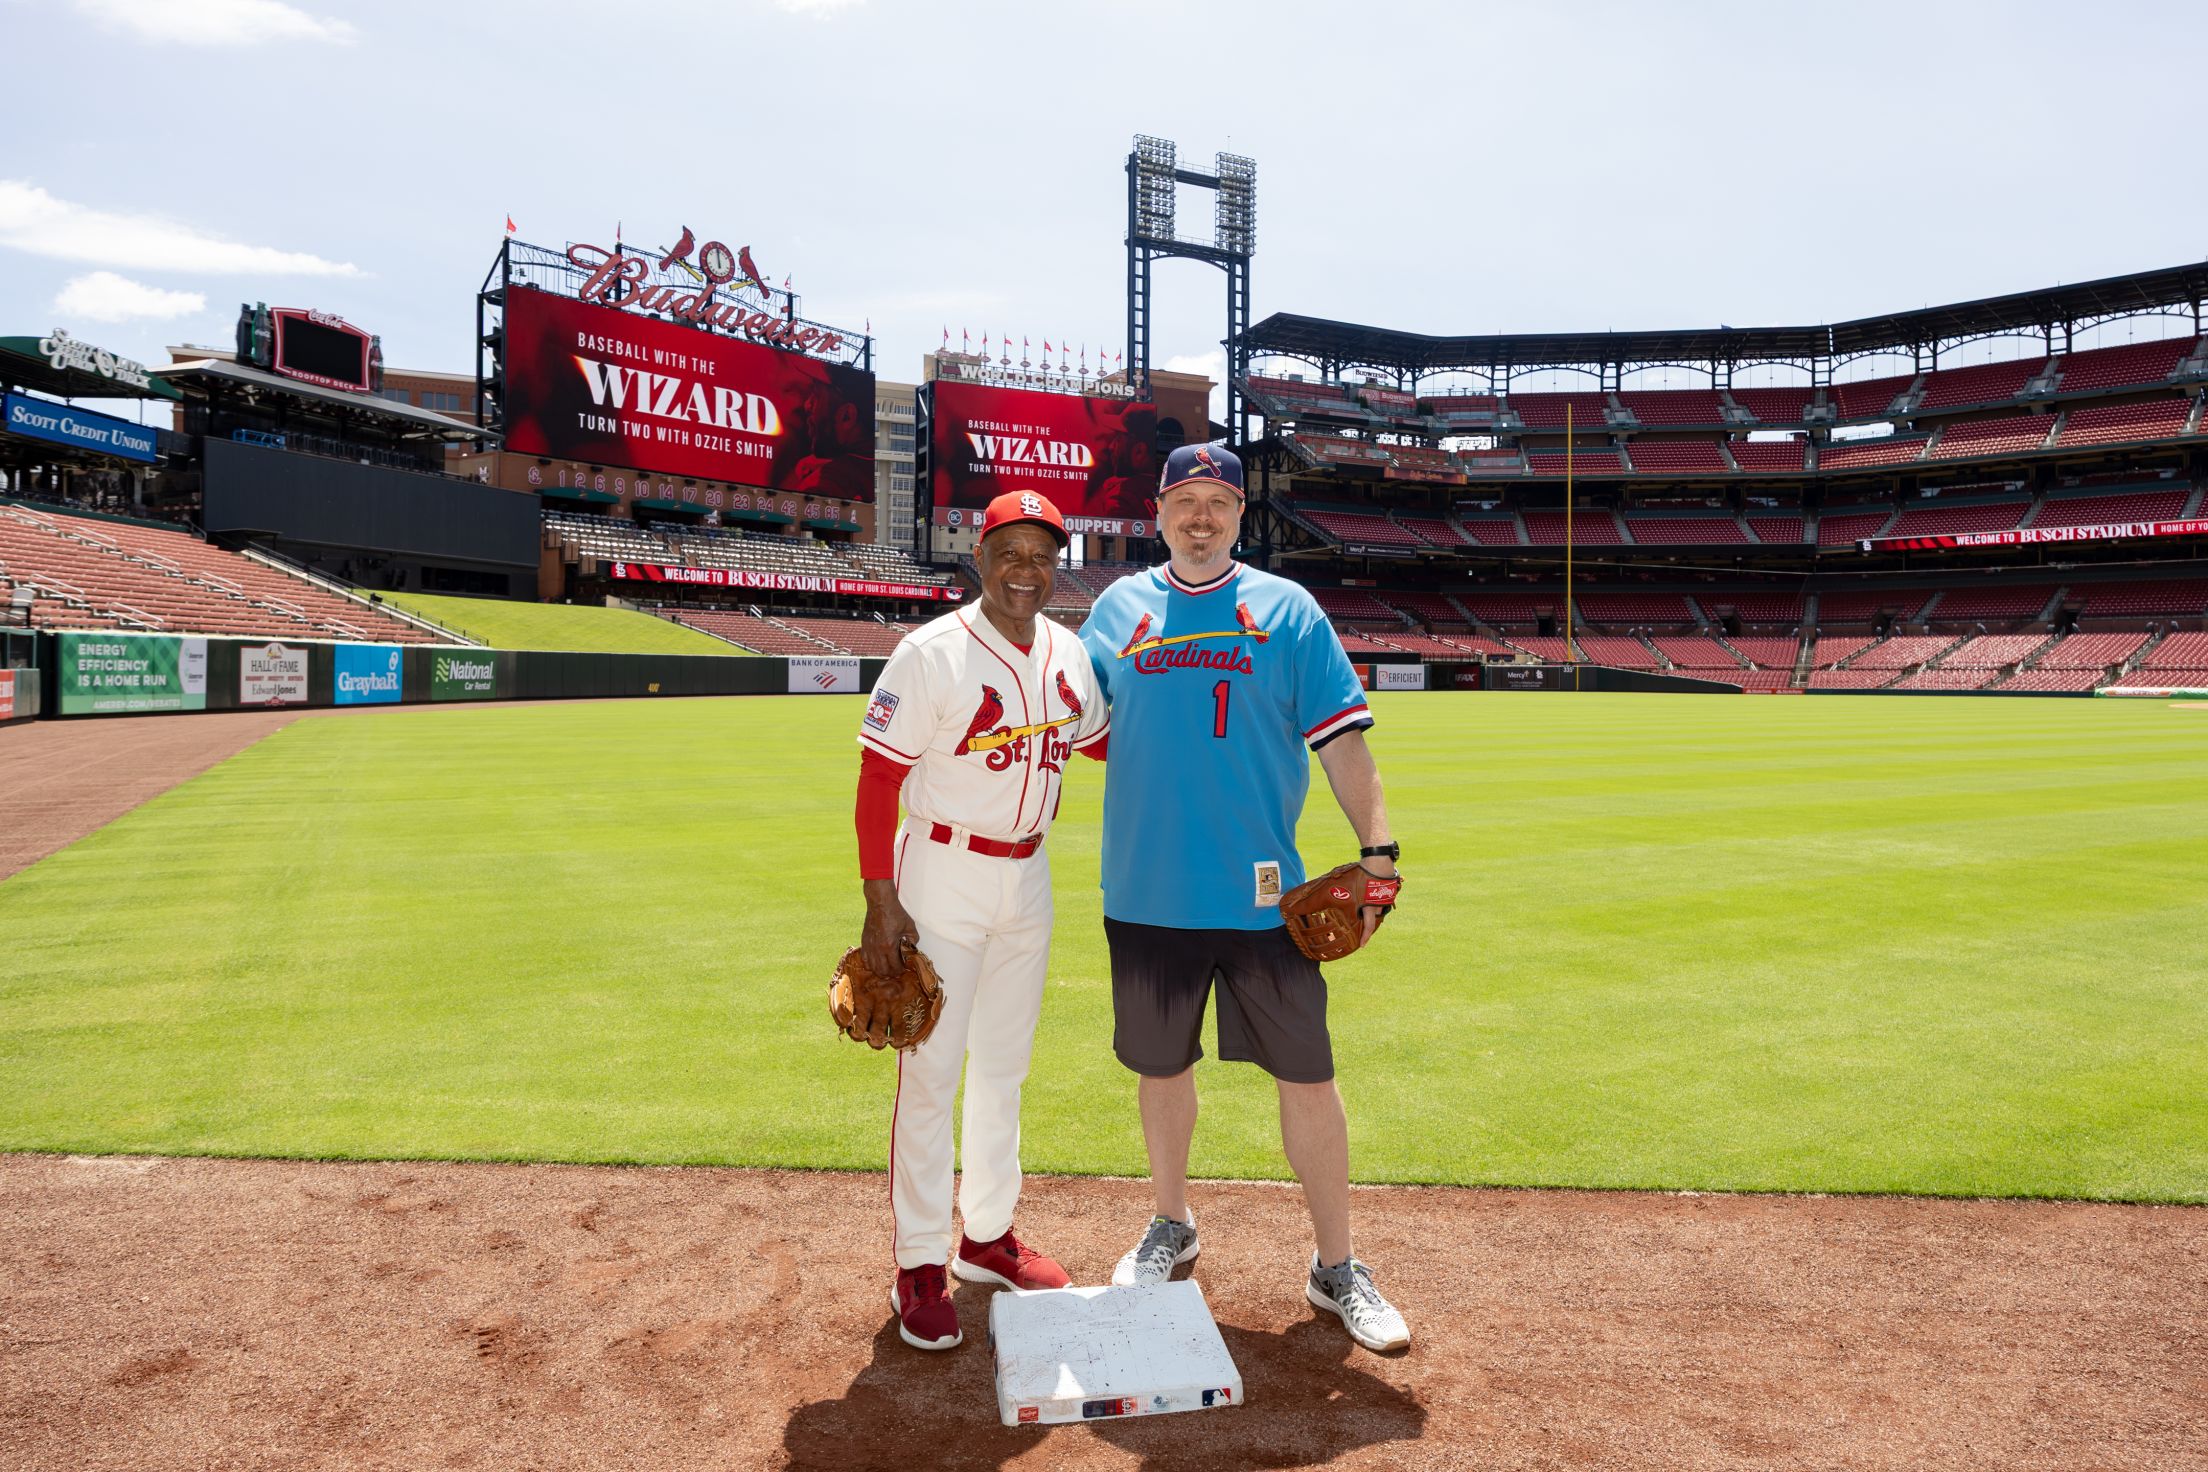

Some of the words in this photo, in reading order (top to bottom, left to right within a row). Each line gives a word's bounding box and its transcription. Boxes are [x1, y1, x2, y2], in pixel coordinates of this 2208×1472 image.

[567, 243, 843, 353] Budweiser
[308, 308, 344, 329] Coca-Cola
[578, 332, 648, 362] BASEBALL
[654, 348, 686, 370] WITH
[691, 356, 716, 376] THE
[115, 371, 152, 389] DECK
[292, 371, 331, 385] ROOFTOP
[333, 380, 354, 390] DECK
[958, 364, 1027, 384] WORLD
[1031, 373, 1136, 397] CHAMPIONS
[574, 354, 785, 436] WIZARD
[11, 405, 59, 431] SCOTT
[60, 417, 110, 443] CREDIT
[111, 429, 152, 453] UNION
[578, 412, 616, 434] TURN
[623, 420, 650, 440] TWO
[656, 426, 689, 446] WITH
[695, 433, 731, 454] OZZIE
[736, 440, 773, 460] SMITH
[968, 419, 1010, 432] BASEBALL
[1012, 423, 1032, 434] WITH
[1035, 426, 1051, 436] THE
[964, 432, 1096, 468] WIZARD
[969, 463, 991, 473] TURN
[994, 465, 1011, 475] TWO
[1014, 466, 1034, 477] WITH
[1037, 468, 1061, 479] OZZIE
[1063, 471, 1088, 481] SMITH
[558, 470, 566, 488] 1
[575, 472, 586, 489] 2
[594, 474, 606, 492] 6
[614, 477, 626, 495] 9
[634, 480, 650, 498] 10
[658, 483, 674, 500] 14
[682, 486, 698, 504] 17
[705, 490, 724, 507] 20
[732, 493, 750, 511] 23
[756, 496, 774, 513] 24
[780, 500, 797, 517] 42
[804, 503, 821, 520] 45
[824, 506, 840, 521] 85
[1063, 518, 1121, 534] OUPPEN
[1956, 535, 2001, 546] WELCOME
[2003, 533, 2015, 543] TO
[2020, 528, 2074, 543] BUSCH
[2076, 522, 2155, 540] STADIUM
[2160, 523, 2183, 533] HOME
[2186, 522, 2195, 531] OF
[2197, 521, 2208, 530] YO
[664, 567, 709, 583] WELCOME
[711, 571, 723, 583] TO
[728, 570, 775, 588] BUSCH
[776, 574, 836, 592] STADIUM
[839, 582, 856, 592] HOME
[857, 583, 864, 592] OF
[864, 584, 879, 593] YOUR
[880, 585, 888, 594] ST.
[889, 585, 904, 595] LOUIS
[904, 586, 933, 597] CARDINALS
[78, 643, 127, 656] ENERGY
[1134, 635, 1253, 675] Cardinals
[78, 660, 149, 671] EFFICIENCY
[251, 660, 272, 673] HALL
[278, 660, 299, 673] FAME
[449, 660, 494, 680] National
[791, 659, 811, 667] BANK
[824, 659, 858, 668] AMERICA
[78, 675, 90, 687] IS
[92, 675, 102, 687] A
[105, 675, 140, 687] HOME
[143, 674, 167, 686] RUN
[338, 671, 399, 696] GraybaR
[464, 681, 474, 690] Car
[474, 681, 491, 690] Rental
[1378, 671, 1422, 684] PERFICIENT
[1507, 671, 1525, 679] Mercy
[1212, 680, 1230, 738] 1
[985, 726, 1029, 772] St.
